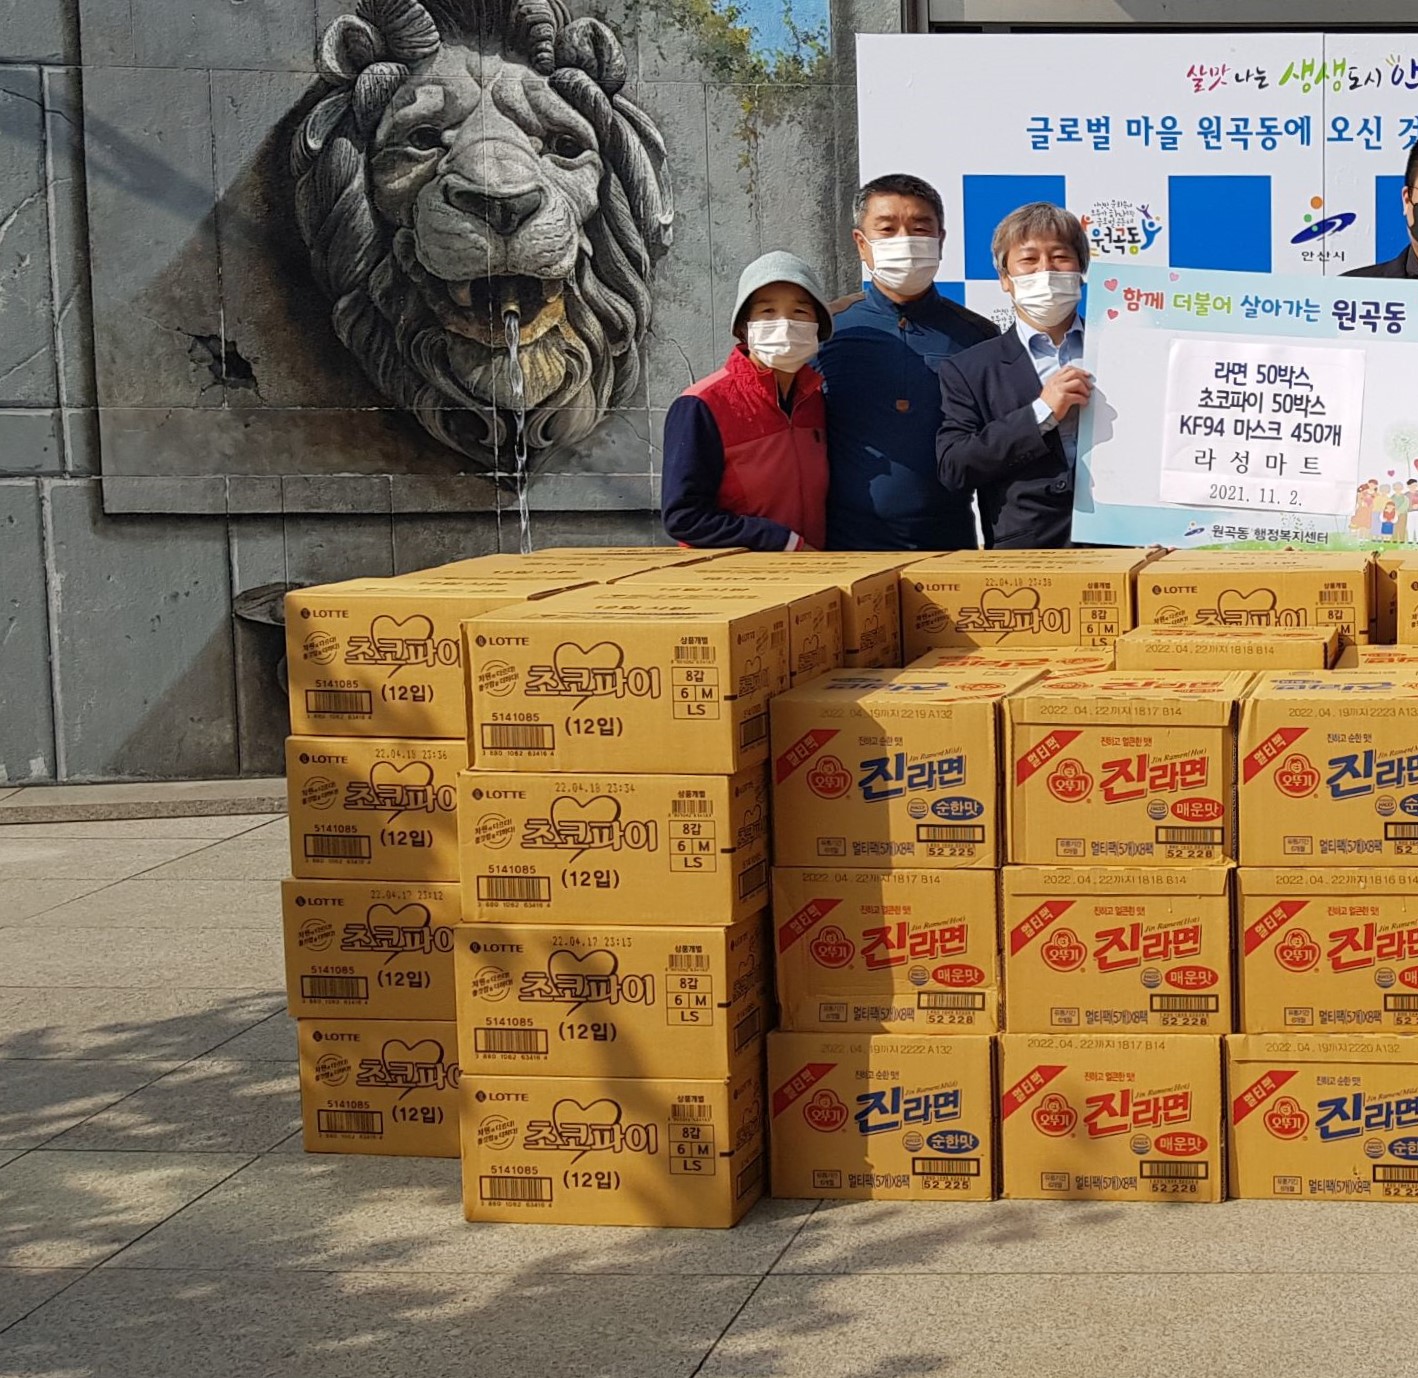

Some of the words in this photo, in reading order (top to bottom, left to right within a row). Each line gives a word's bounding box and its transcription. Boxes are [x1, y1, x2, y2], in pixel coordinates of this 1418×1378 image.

[1027, 116, 1110, 150] 글로벌
[1126, 116, 1183, 150] 마을
[1197, 116, 1311, 150] 원곡동에
[1327, 116, 1382, 150] 오신
[1091, 226, 1141, 254] 원곡동
[1301, 251, 1345, 262] 안산시
[1122, 287, 1164, 312] 함께
[1172, 292, 1232, 316] 더불어
[1240, 294, 1321, 322] 살아가는
[1332, 299, 1406, 333] 원곡동
[1215, 362, 1247, 386] 라면
[1256, 364, 1313, 392] 50박스,
[1198, 387, 1263, 413] 초코파이
[1272, 393, 1326, 418] 50박스
[1180, 415, 1225, 436] KF94
[1234, 419, 1282, 441] 마스크
[1291, 423, 1341, 447] 450개
[1210, 484, 1249, 502] 2021.
[1260, 488, 1280, 504] 11.
[1290, 491, 1302, 506] 2.
[1212, 525, 1249, 540] 원곡동
[1255, 528, 1328, 544] 행정복지센터
[313, 610, 349, 618] LOTTE
[956, 607, 1070, 634] 초코파이
[489, 637, 529, 645] LOTTE
[316, 680, 358, 688] 5141085
[525, 666, 661, 699] 초코파이
[686, 670, 705, 682] 8갑
[381, 684, 434, 702] (12입)
[680, 688, 688, 698] 6
[702, 689, 713, 698] M
[492, 713, 539, 721] 5141085
[688, 705, 705, 715] LS
[565, 717, 623, 736] (12입)
[312, 755, 348, 763] LOTTE
[857, 751, 964, 803] 진라면
[1099, 752, 1206, 804] 진라면
[1283, 774, 1312, 788] 오뚜기
[486, 791, 526, 799] LOTTE
[936, 800, 979, 818] 순한맛
[1176, 801, 1220, 819] 매운맛
[380, 829, 433, 847] (12입)
[521, 819, 658, 852] 초코파이
[1396, 845, 1413, 855] 52
[488, 865, 536, 873] 5141085
[561, 869, 620, 888] (12입)
[308, 898, 345, 906] LOTTE
[484, 944, 524, 952] LOTTE
[860, 920, 966, 970] 진라면
[1092, 921, 1200, 973] 진라면
[377, 970, 430, 988] (12입)
[937, 968, 980, 985] 매운맛
[1170, 969, 1214, 987] 매운맛
[519, 972, 655, 1005] 초코파이
[486, 1018, 533, 1026] 5141085
[928, 1015, 944, 1023] 52
[950, 1014, 974, 1023] 228
[324, 1033, 360, 1041] LOTTE
[559, 1022, 617, 1041] (12입)
[489, 1093, 529, 1101] LOTTE
[392, 1105, 443, 1123] (12입)
[854, 1085, 960, 1136] 진라면
[1083, 1087, 1189, 1139] 진라면
[524, 1121, 658, 1154] 초코파이
[931, 1133, 975, 1151] 순한맛
[1160, 1136, 1203, 1154] 매운맛
[491, 1166, 538, 1174] 5141085
[563, 1170, 620, 1189] (12입)
[1384, 1188, 1401, 1196] 52
